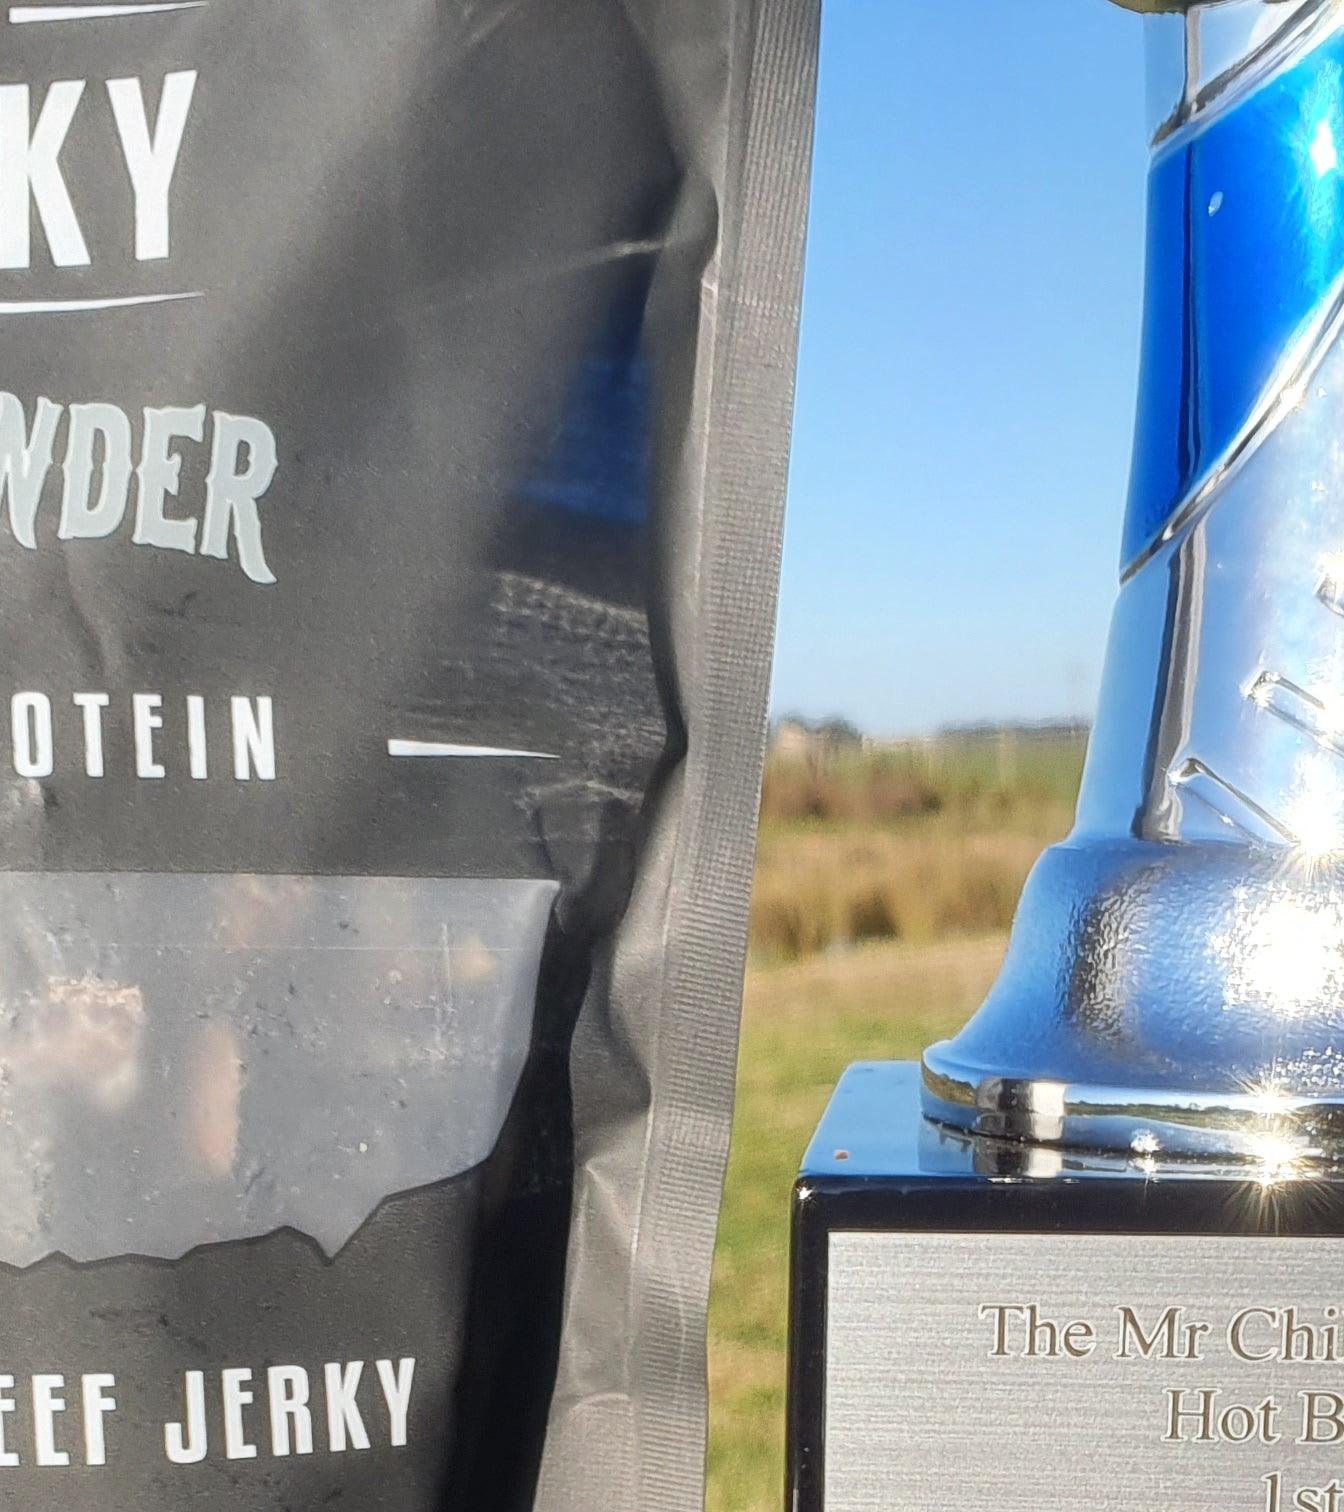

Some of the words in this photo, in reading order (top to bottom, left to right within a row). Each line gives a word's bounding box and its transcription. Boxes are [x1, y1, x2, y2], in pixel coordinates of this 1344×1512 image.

[981, 1305, 1096, 1360] The
[1114, 1307, 1210, 1361] Mr
[164, 1357, 417, 1466] JERKY
[1162, 1389, 1280, 1445] Hot
